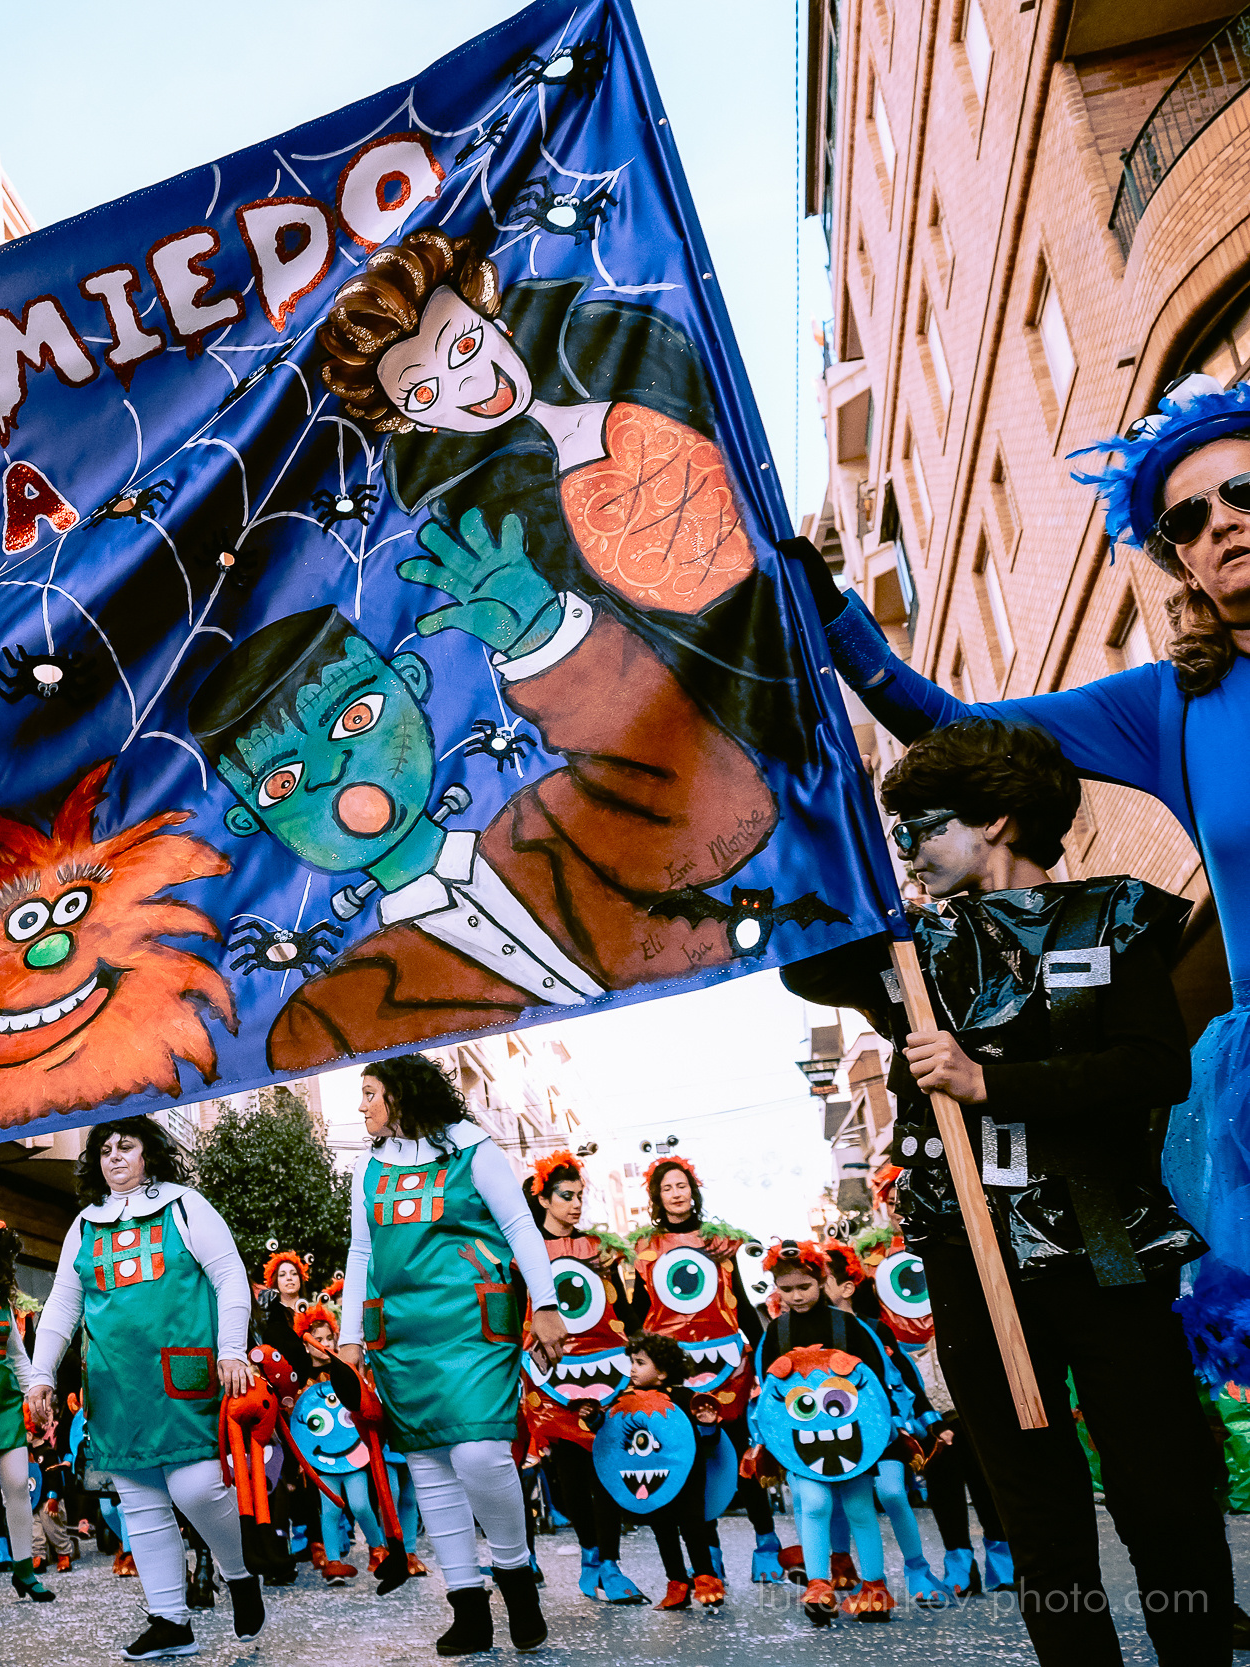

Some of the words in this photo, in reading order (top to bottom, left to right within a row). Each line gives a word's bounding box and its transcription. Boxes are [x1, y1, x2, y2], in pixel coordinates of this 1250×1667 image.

[663, 853, 698, 889] Emi
[706, 809, 765, 868] Montse
[639, 933, 665, 961] Eli
[680, 941, 714, 969] Isa
